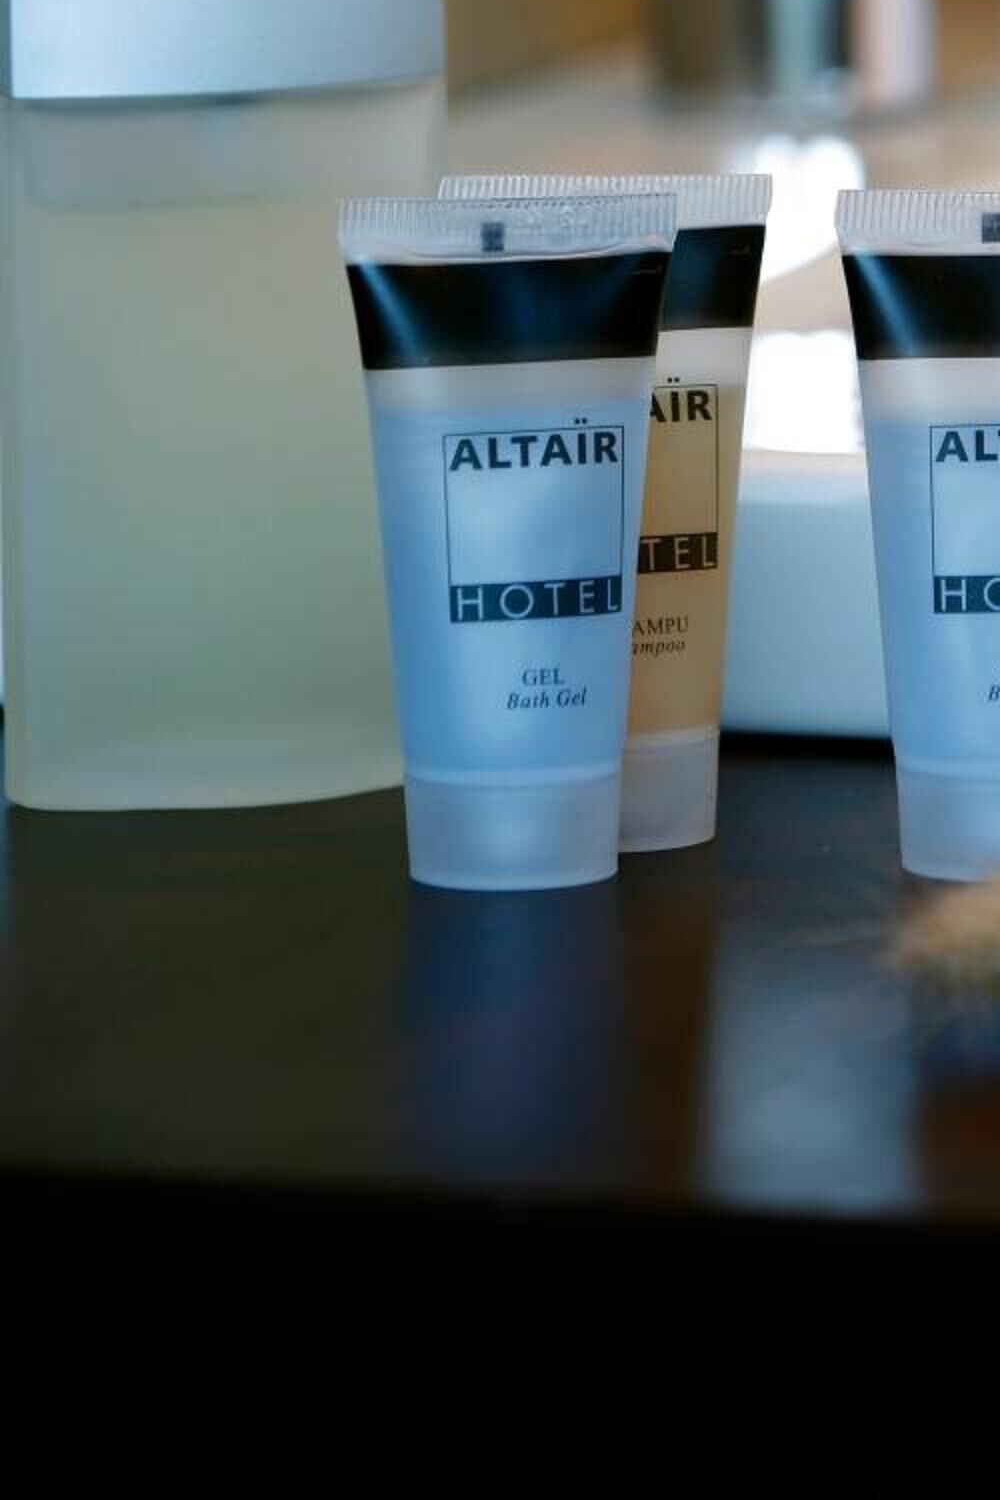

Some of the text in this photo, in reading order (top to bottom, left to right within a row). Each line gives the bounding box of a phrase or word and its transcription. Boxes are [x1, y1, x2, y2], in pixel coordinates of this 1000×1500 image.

[650, 376, 713, 422] AÏR
[449, 417, 619, 471] ALTAÏR
[640, 535, 715, 571] TEL
[456, 578, 619, 622] HOTEL
[632, 615, 689, 635] AMPU
[521, 667, 566, 687] GEL
[506, 687, 588, 711] Bath Gel
